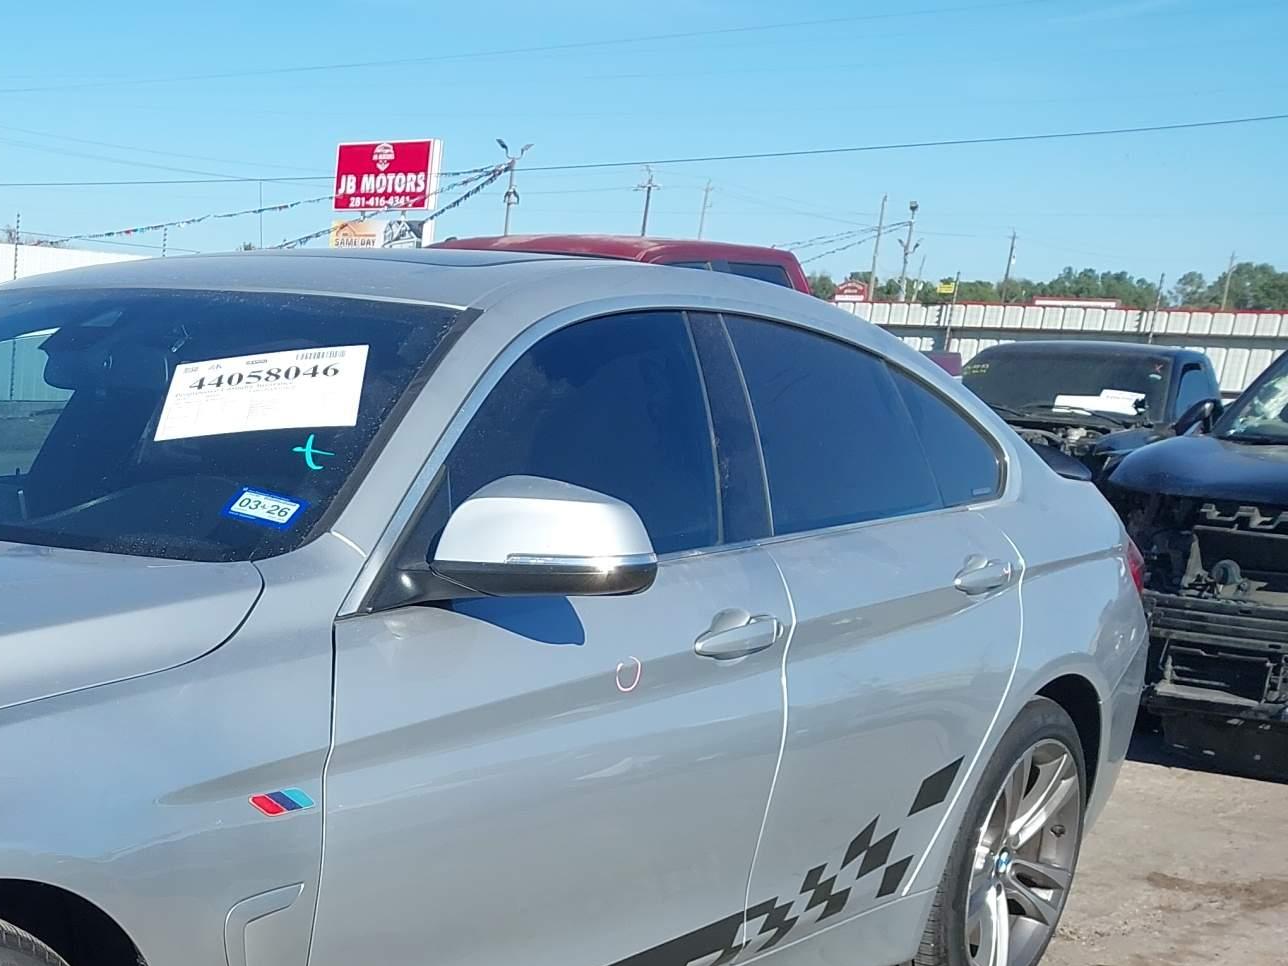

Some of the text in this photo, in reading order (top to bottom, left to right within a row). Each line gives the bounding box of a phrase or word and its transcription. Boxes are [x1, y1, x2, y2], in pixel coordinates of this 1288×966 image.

[338, 172, 425, 195] JB MOTORS
[334, 238, 377, 246] SAME DAY
[188, 362, 340, 391] 44058046
